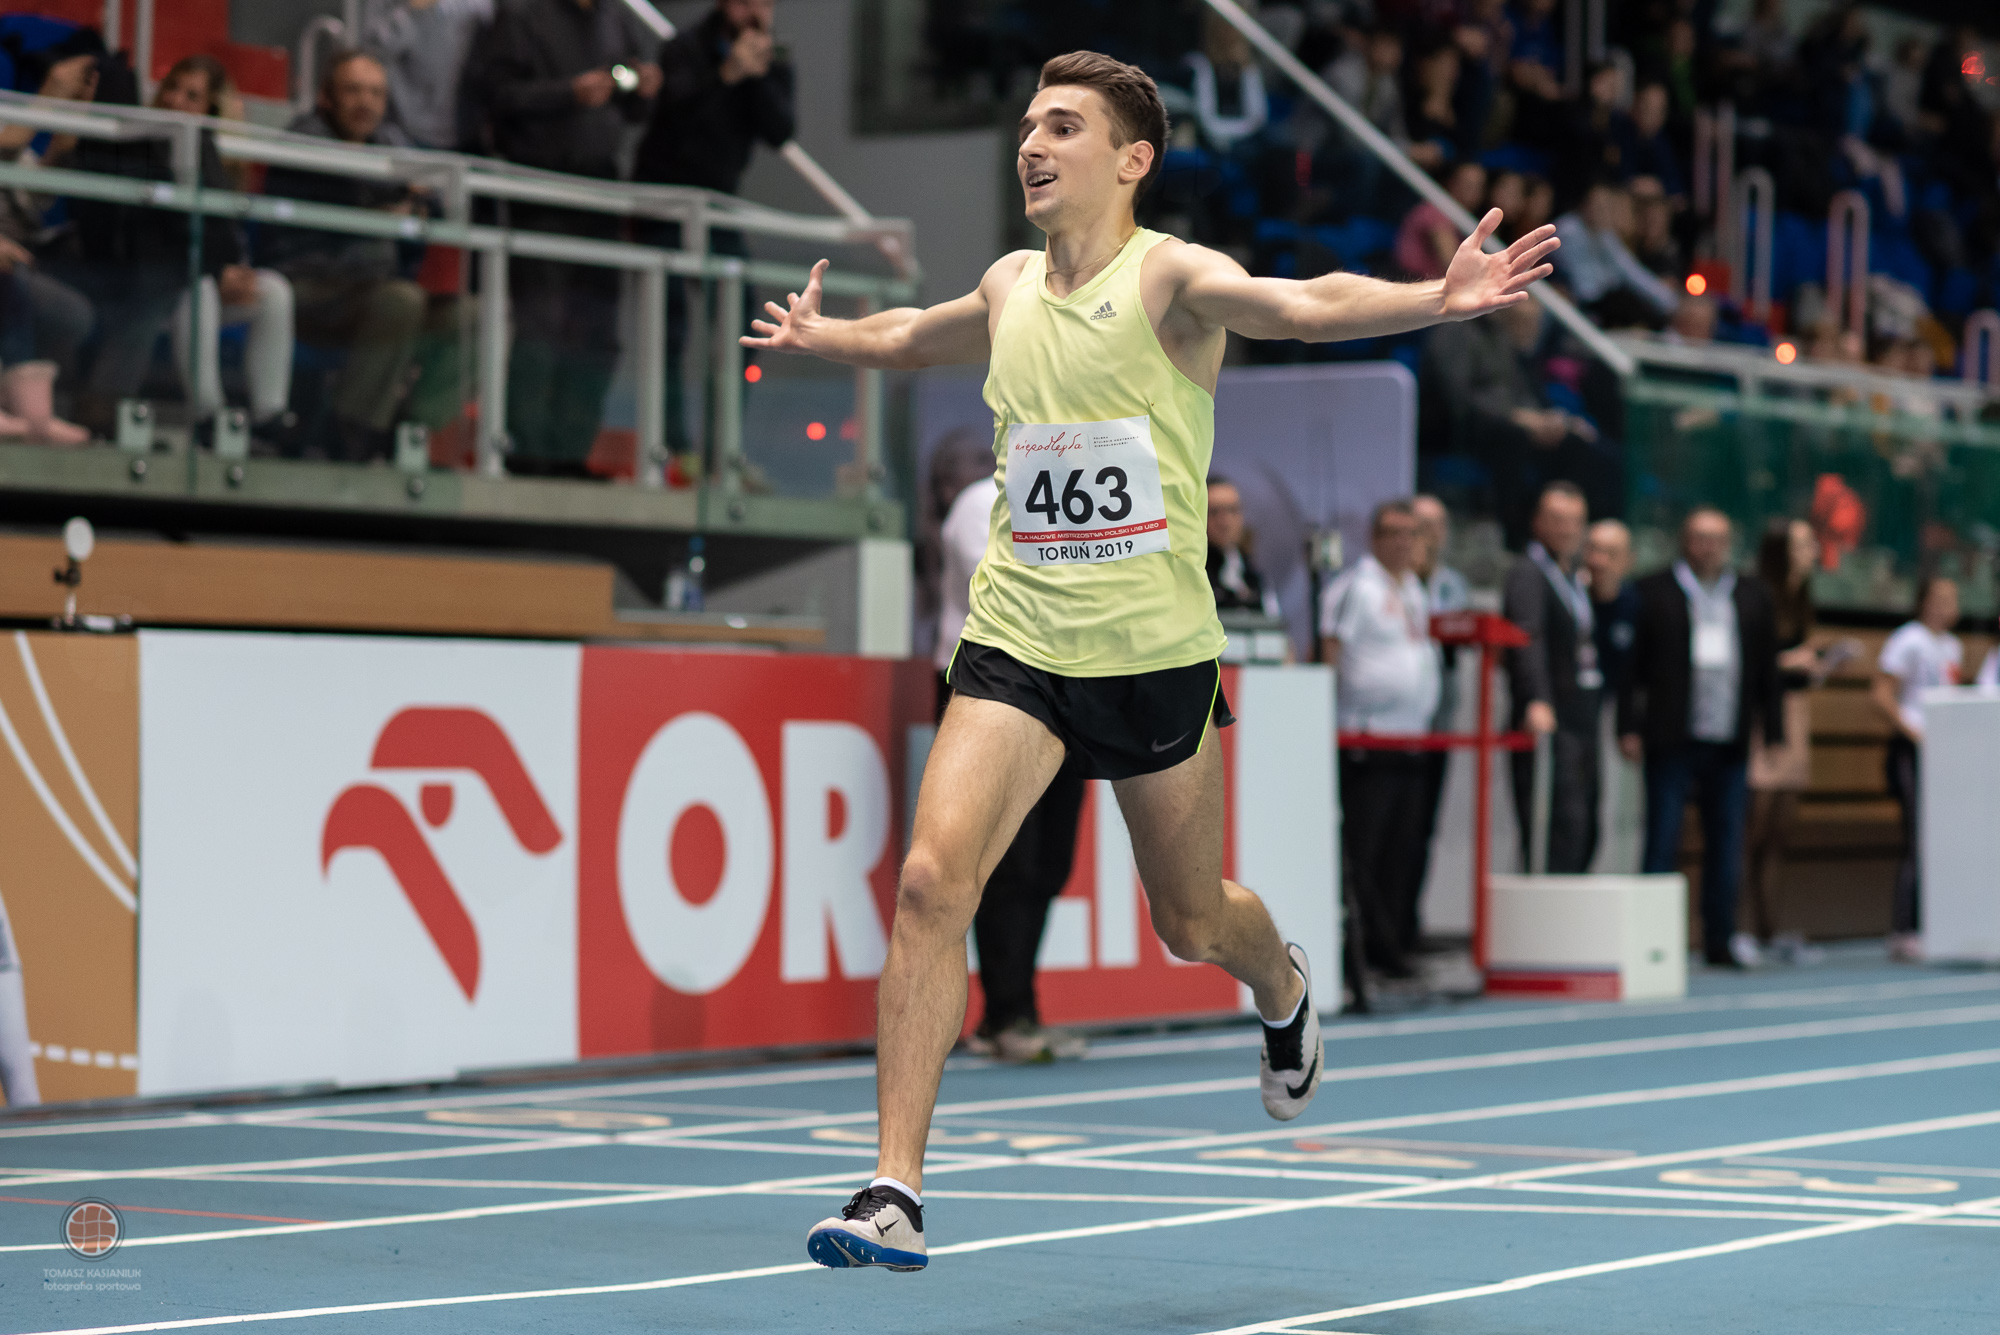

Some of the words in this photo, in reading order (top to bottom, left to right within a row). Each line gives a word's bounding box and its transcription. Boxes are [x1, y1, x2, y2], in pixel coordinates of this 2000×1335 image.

[1090, 311, 1117, 320] adidas
[1025, 466, 1132, 525] 463
[1057, 531, 1103, 539] MISTRZOSTWA
[1104, 529, 1129, 537] POLSKI
[1130, 525, 1144, 533] U18
[1144, 522, 1159, 530] U20
[1038, 541, 1090, 561] TORUŃ
[1095, 540, 1134, 558] 2019
